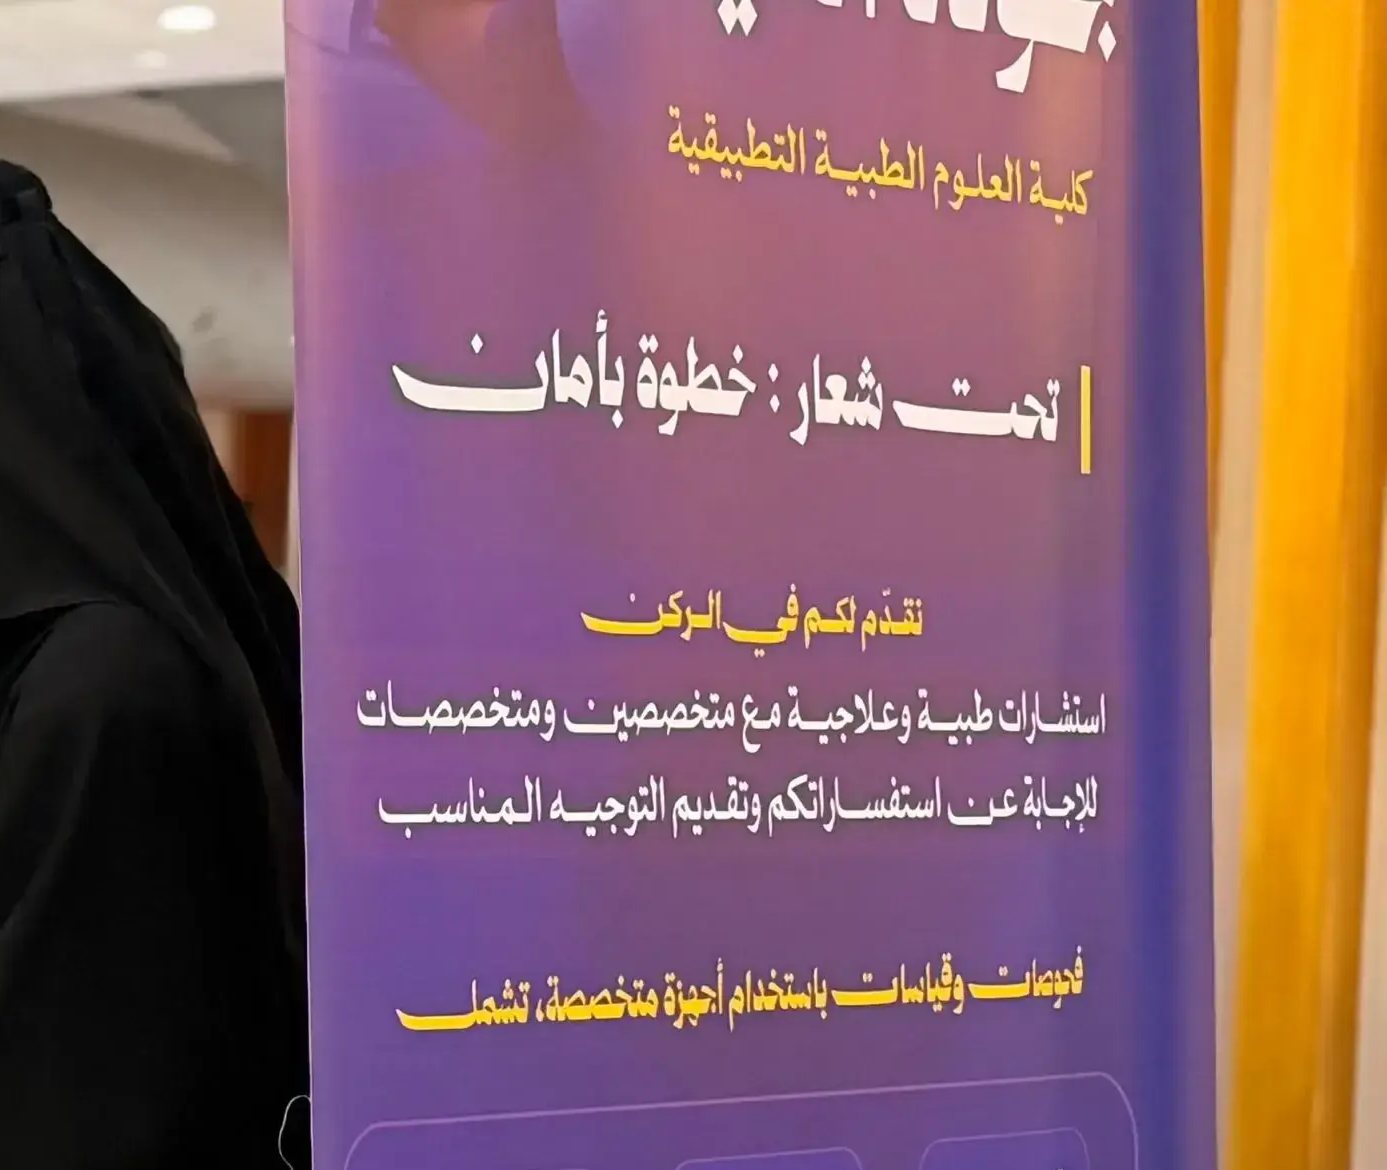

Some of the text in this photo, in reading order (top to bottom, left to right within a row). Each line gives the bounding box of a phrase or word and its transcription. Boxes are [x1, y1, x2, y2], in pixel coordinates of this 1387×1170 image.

[669, 106, 1093, 224] كلية العلوم الطبية التطبيقية
[393, 310, 624, 428] بأمان
[637, 335, 756, 435] خطوة
[893, 378, 1060, 441] تحت
[581, 590, 721, 640] الركن
[723, 584, 798, 657] في
[804, 596, 856, 638] لكم
[357, 680, 1105, 753] استشارات طبية وعلاجية مع متخصصين ومتخصصات
[379, 774, 1097, 838] للإجابة عن استفساراتكم وتقديم التوجيه المناسب
[396, 979, 530, 1030] تشمل
[664, 958, 723, 1029] أجهزة
[729, 968, 827, 1031] باستخدام
[831, 953, 964, 1014] وقياسات
[968, 946, 1083, 1008] فحوصات
